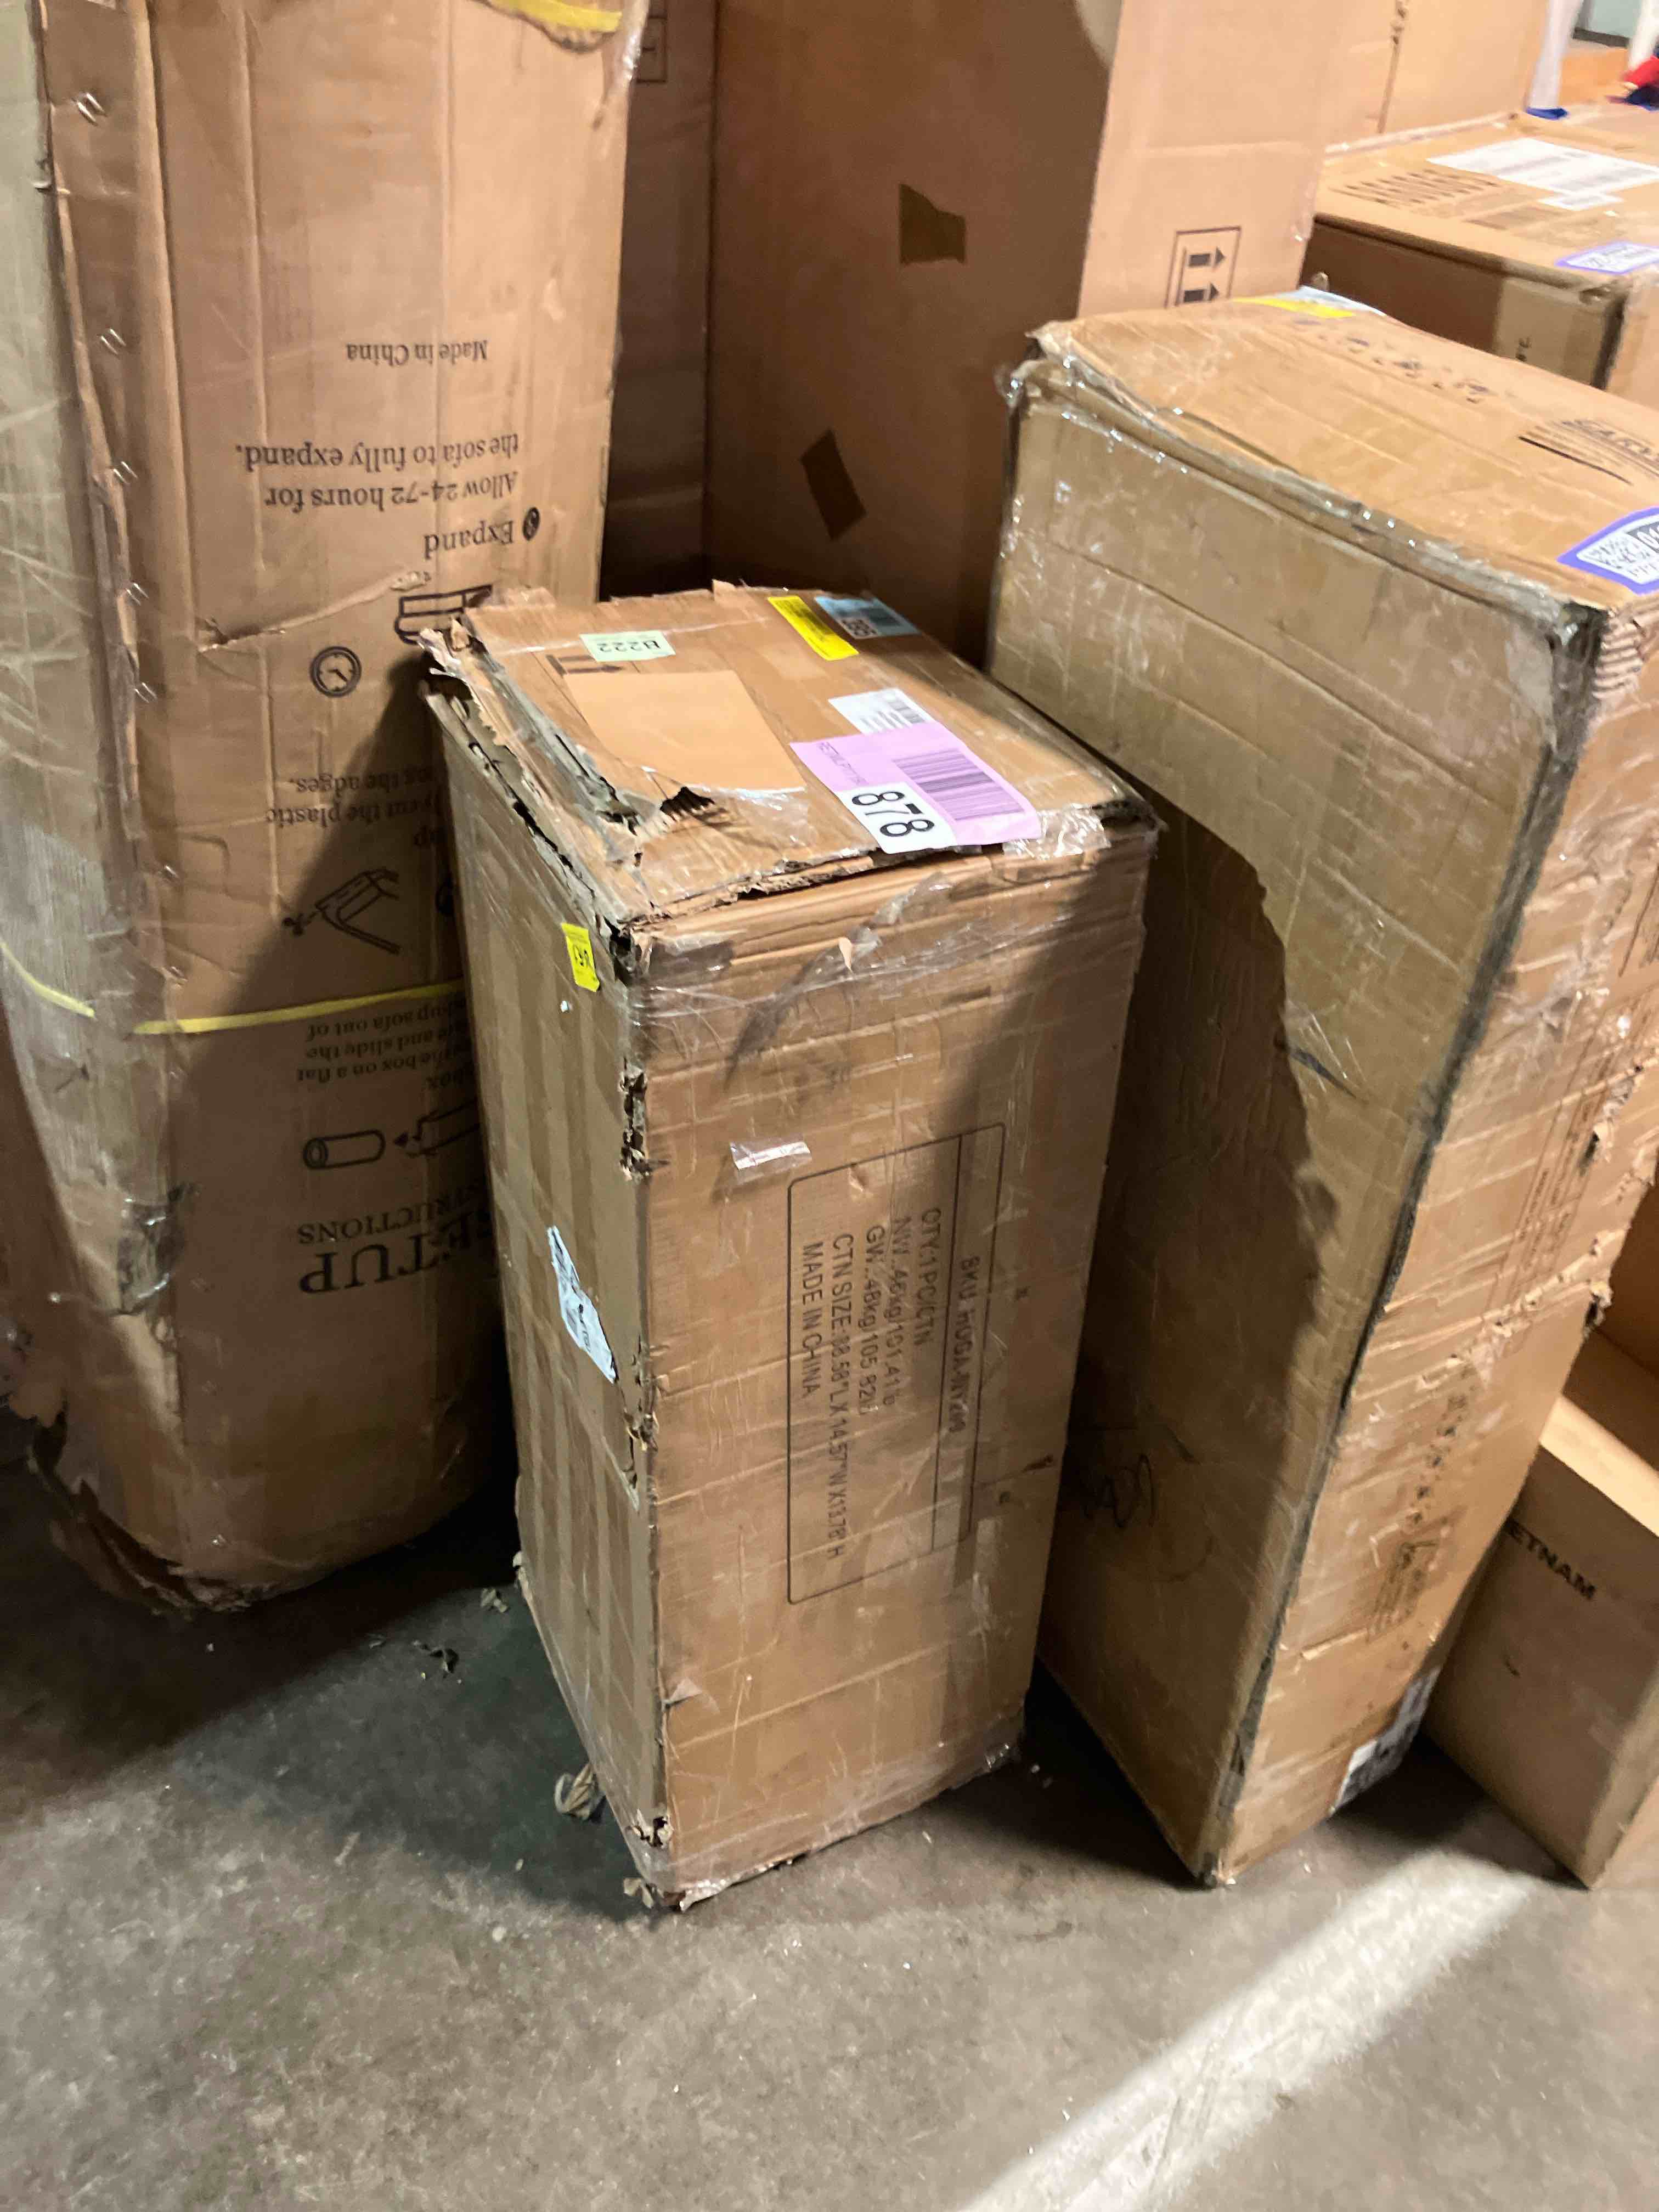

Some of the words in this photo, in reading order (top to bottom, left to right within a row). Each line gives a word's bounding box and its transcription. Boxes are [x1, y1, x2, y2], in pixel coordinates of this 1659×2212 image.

[346, 343, 409, 366] China
[414, 343, 435, 363] in
[440, 340, 488, 365] Made
[235, 442, 343, 472] expand.
[350, 442, 407, 472] fully
[414, 445, 435, 464] to
[443, 439, 485, 467] sofa
[489, 433, 518, 457] the
[392, 482, 458, 506] 24-72
[461, 471, 518, 499] Allow
[264, 487, 303, 514] for
[312, 485, 385, 511] hours
[424, 520, 514, 560] Expand
[264, 803, 341, 828] plastic
[850, 790, 934, 837] 878
[305, 1024, 329, 1042] of
[335, 1020, 368, 1035] out
[373, 1012, 413, 1033] sofa
[305, 1046, 340, 1062] the
[344, 1039, 393, 1058] slide
[337, 1067, 348, 1079] a
[352, 1063, 376, 1076] on
[382, 1056, 416, 1070] box
[296, 1068, 330, 1083] flat
[832, 1234, 854, 1277] CTN
[802, 1242, 824, 1305] MADE
[803, 1310, 822, 1330] IN
[802, 1334, 822, 1399] CHINA
[1505, 1517, 1596, 1599] ETNAM
